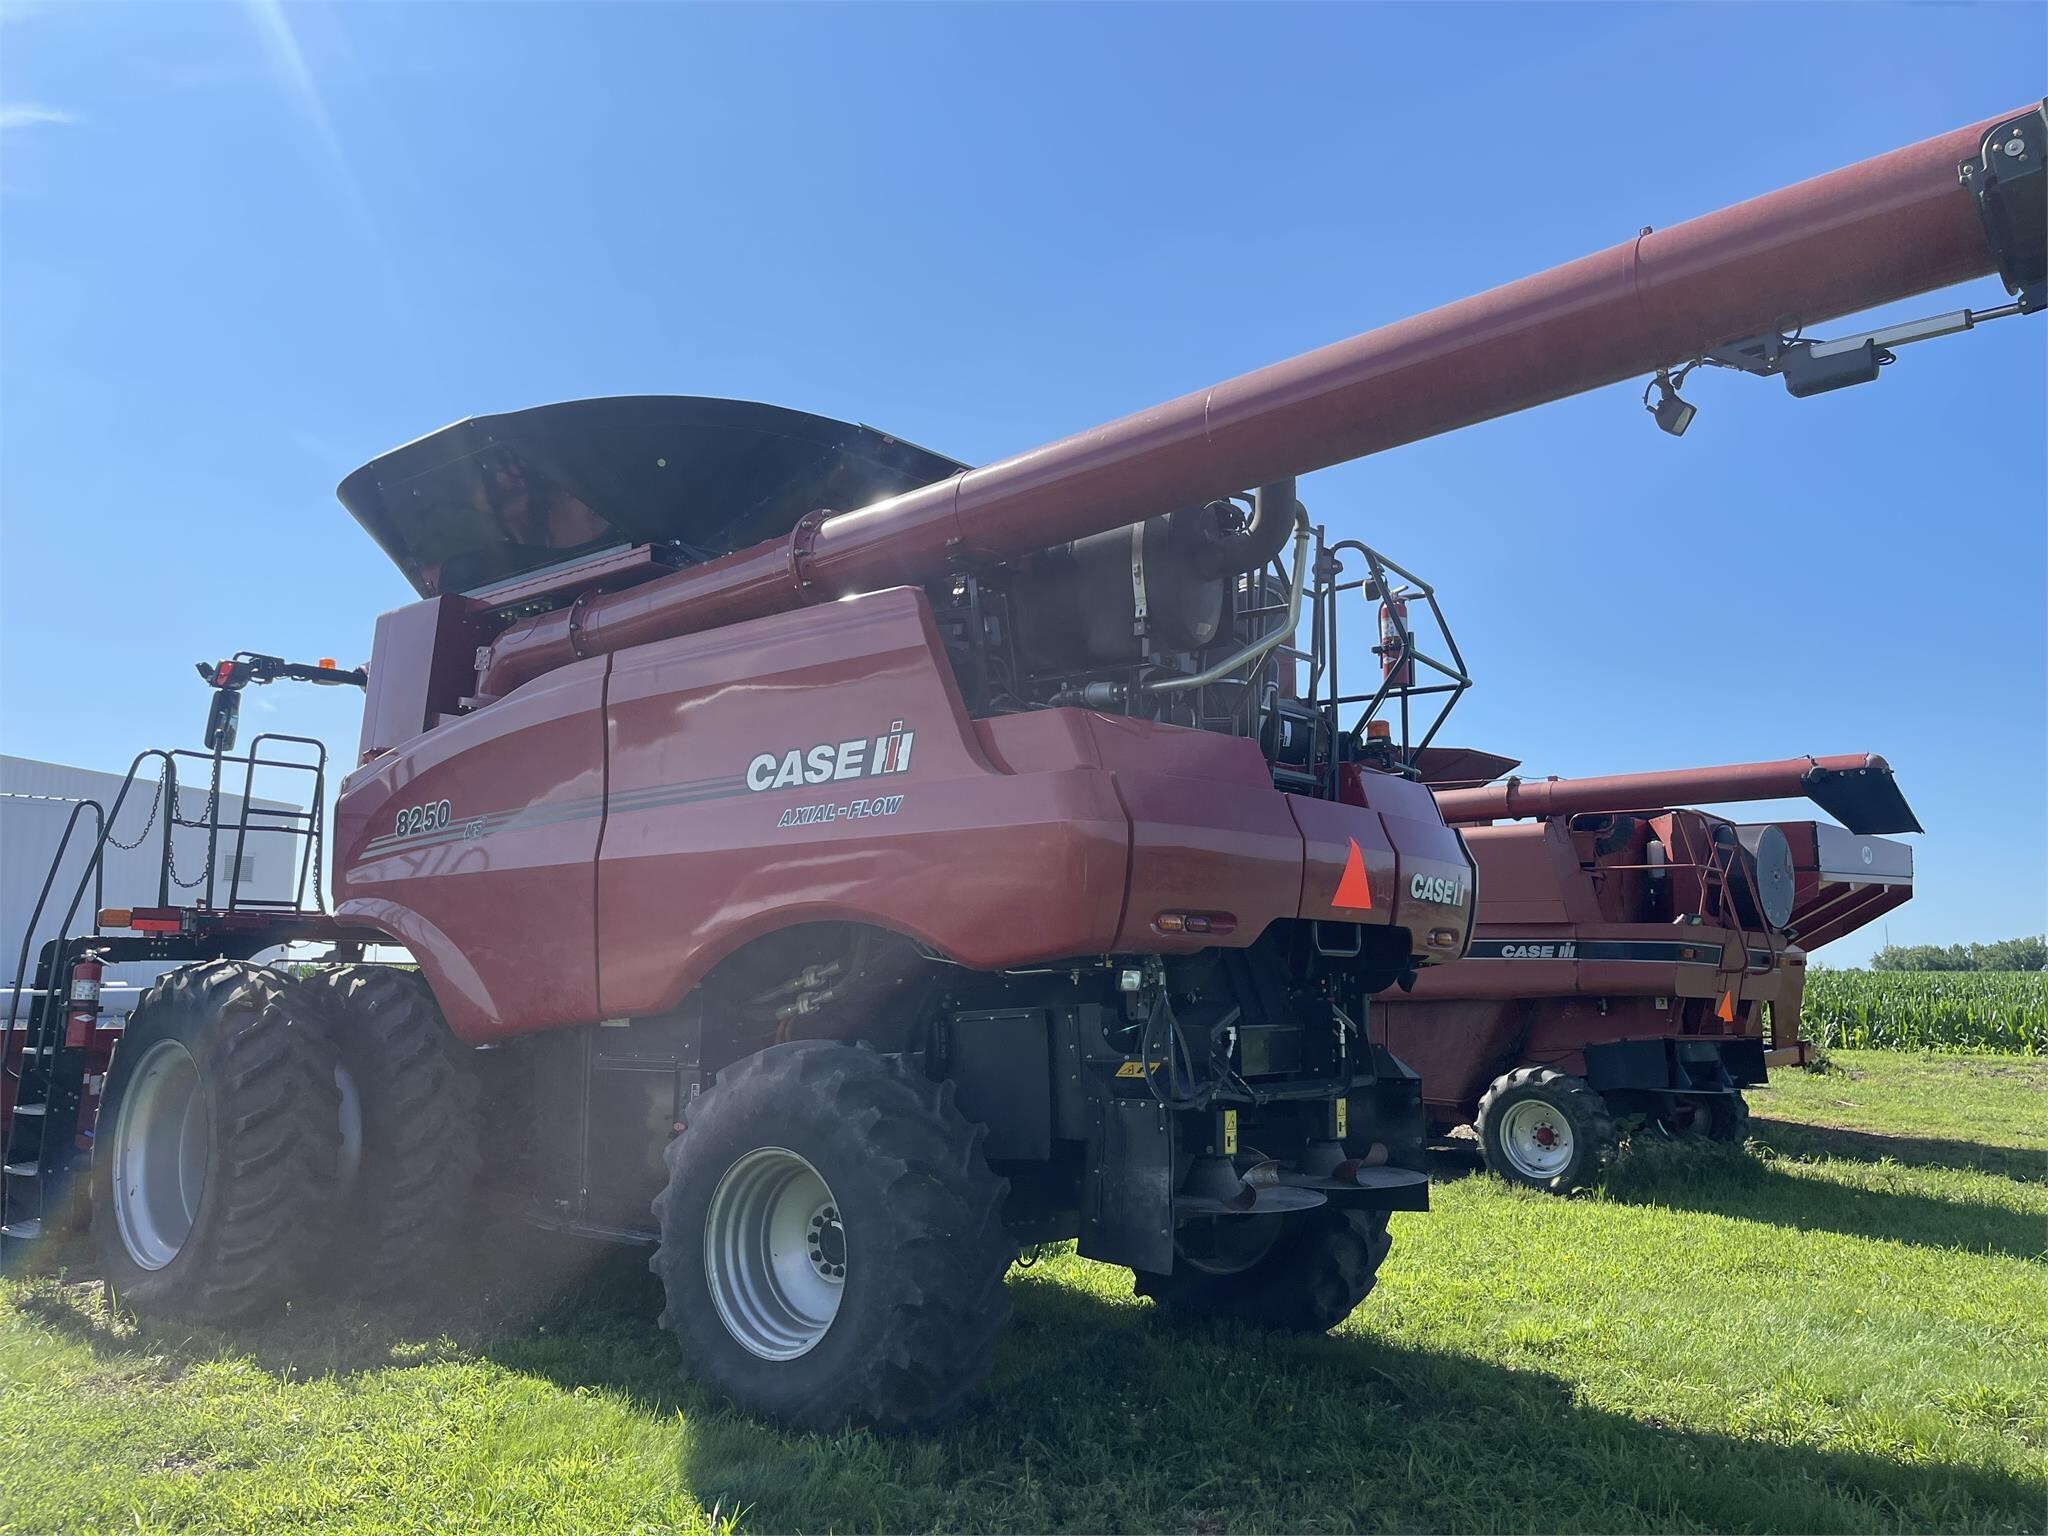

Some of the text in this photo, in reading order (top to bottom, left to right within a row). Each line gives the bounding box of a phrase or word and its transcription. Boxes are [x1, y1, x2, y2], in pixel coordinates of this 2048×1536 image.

[746, 739, 867, 792] CASE
[395, 799, 452, 839] 8250
[777, 795, 904, 828] AXIAL-FLOW
[1410, 873, 1454, 904] CASE
[1501, 944, 1554, 958] CASE
